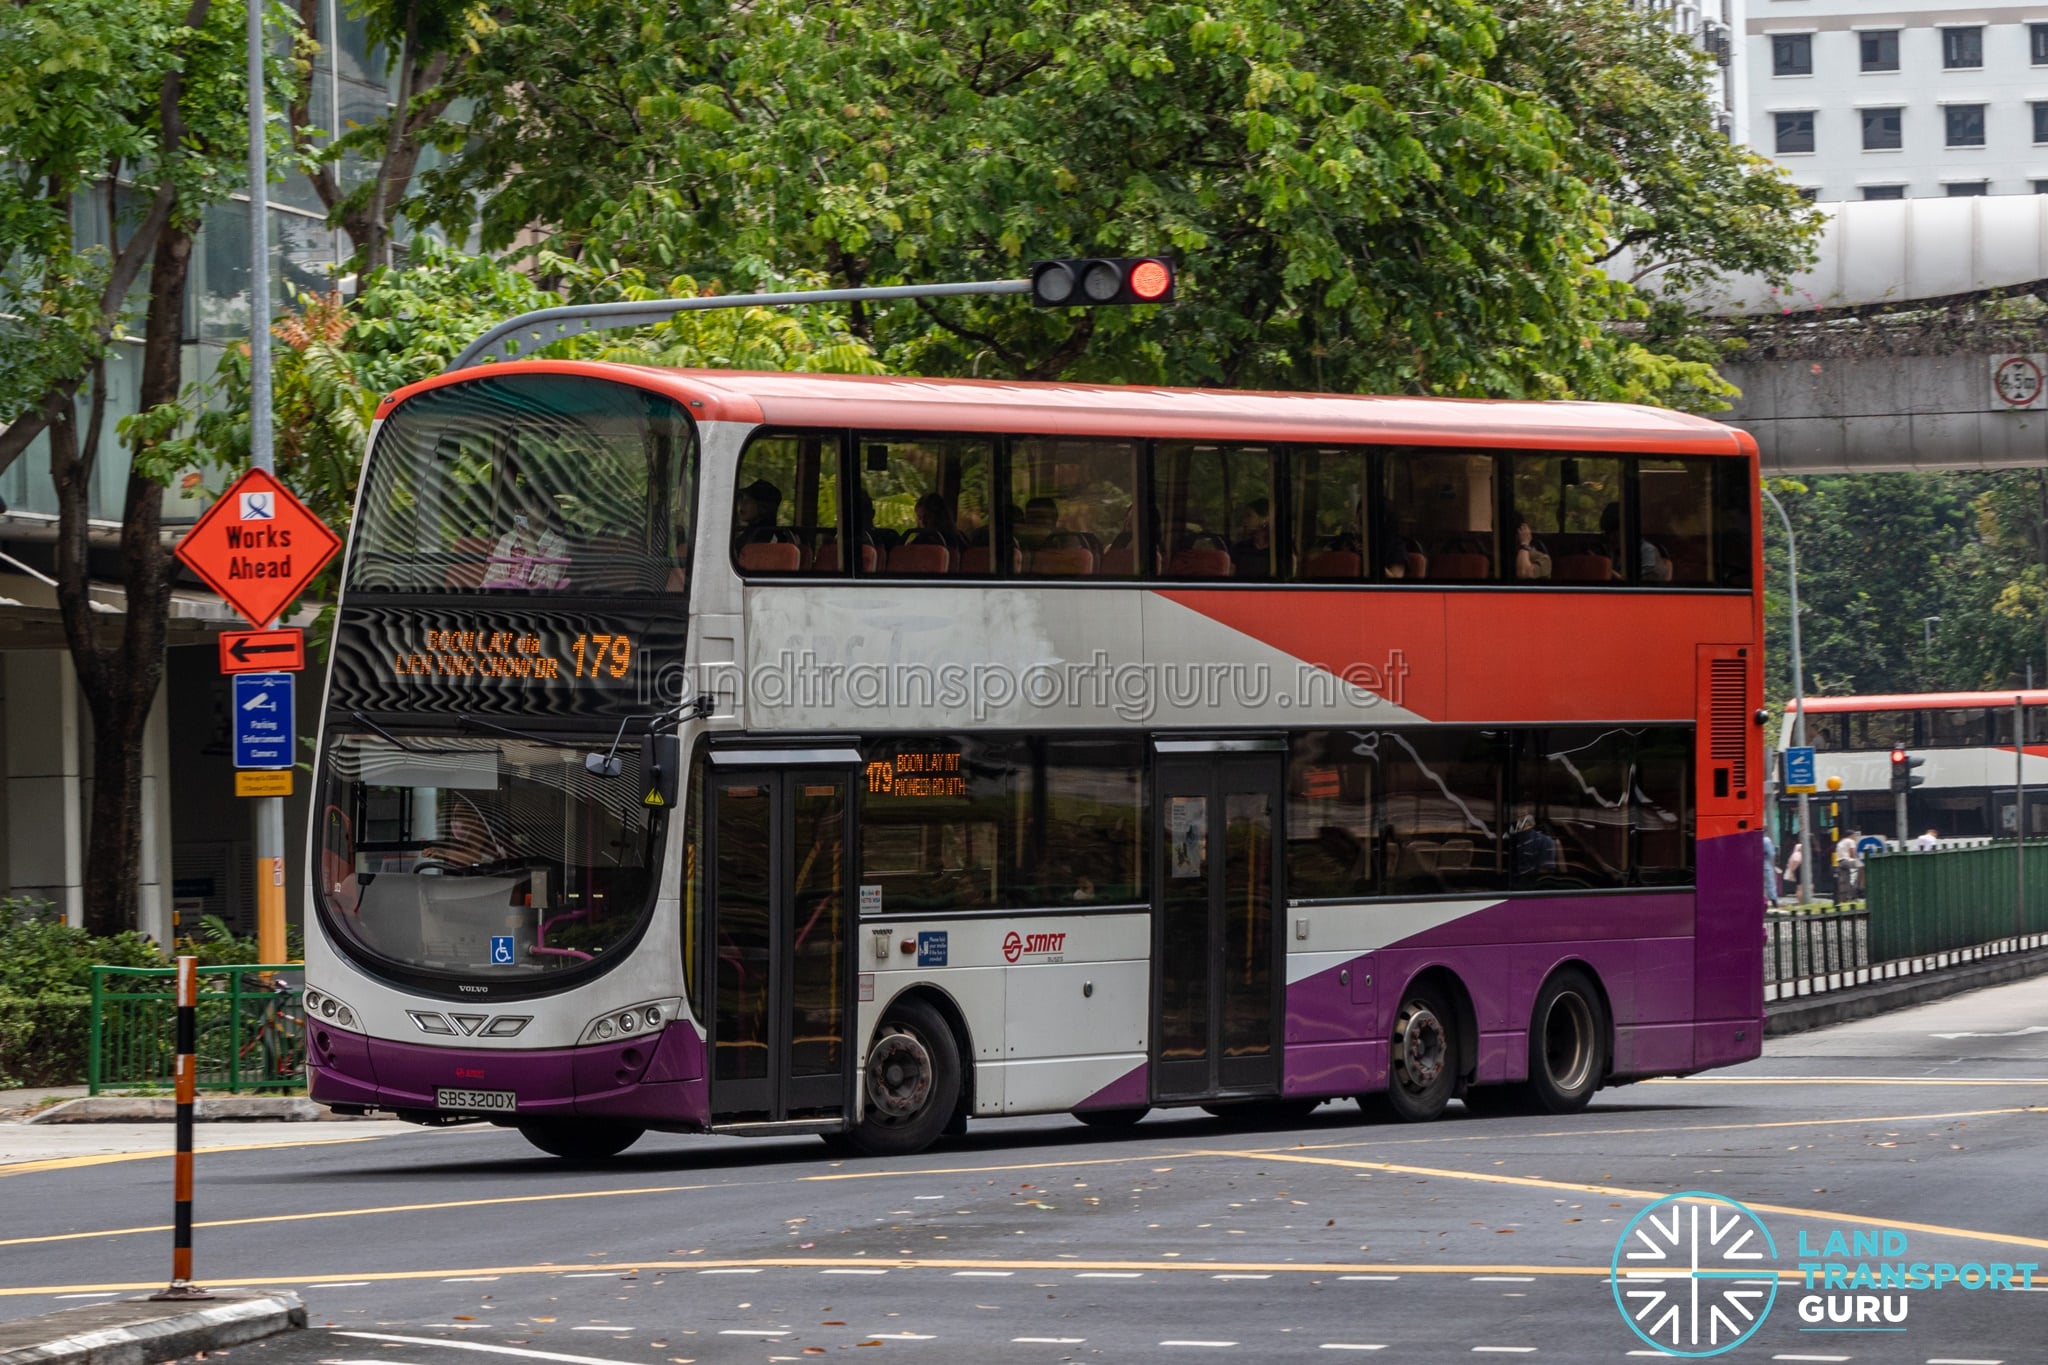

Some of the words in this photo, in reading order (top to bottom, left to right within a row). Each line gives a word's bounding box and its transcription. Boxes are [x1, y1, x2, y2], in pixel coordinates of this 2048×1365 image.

[1999, 372, 2036, 390] 4.5m
[226, 525, 291, 549] Works
[228, 554, 292, 580] Ahead
[426, 629, 475, 652] BOON
[477, 631, 513, 653] LAY
[517, 633, 541, 654] via
[394, 654, 432, 676] LIEN
[437, 654, 475, 677] YING
[479, 656, 531, 679] CHOW
[534, 657, 559, 679] DR
[572, 633, 632, 679] 179
[896, 754, 923, 773] BOON
[925, 753, 944, 772] LAY
[945, 753, 961, 772] INT
[865, 761, 893, 793] 179
[1023, 931, 1067, 953] SMRT
[458, 984, 489, 993] VOLVO
[439, 1090, 515, 1109] SBS3200X
